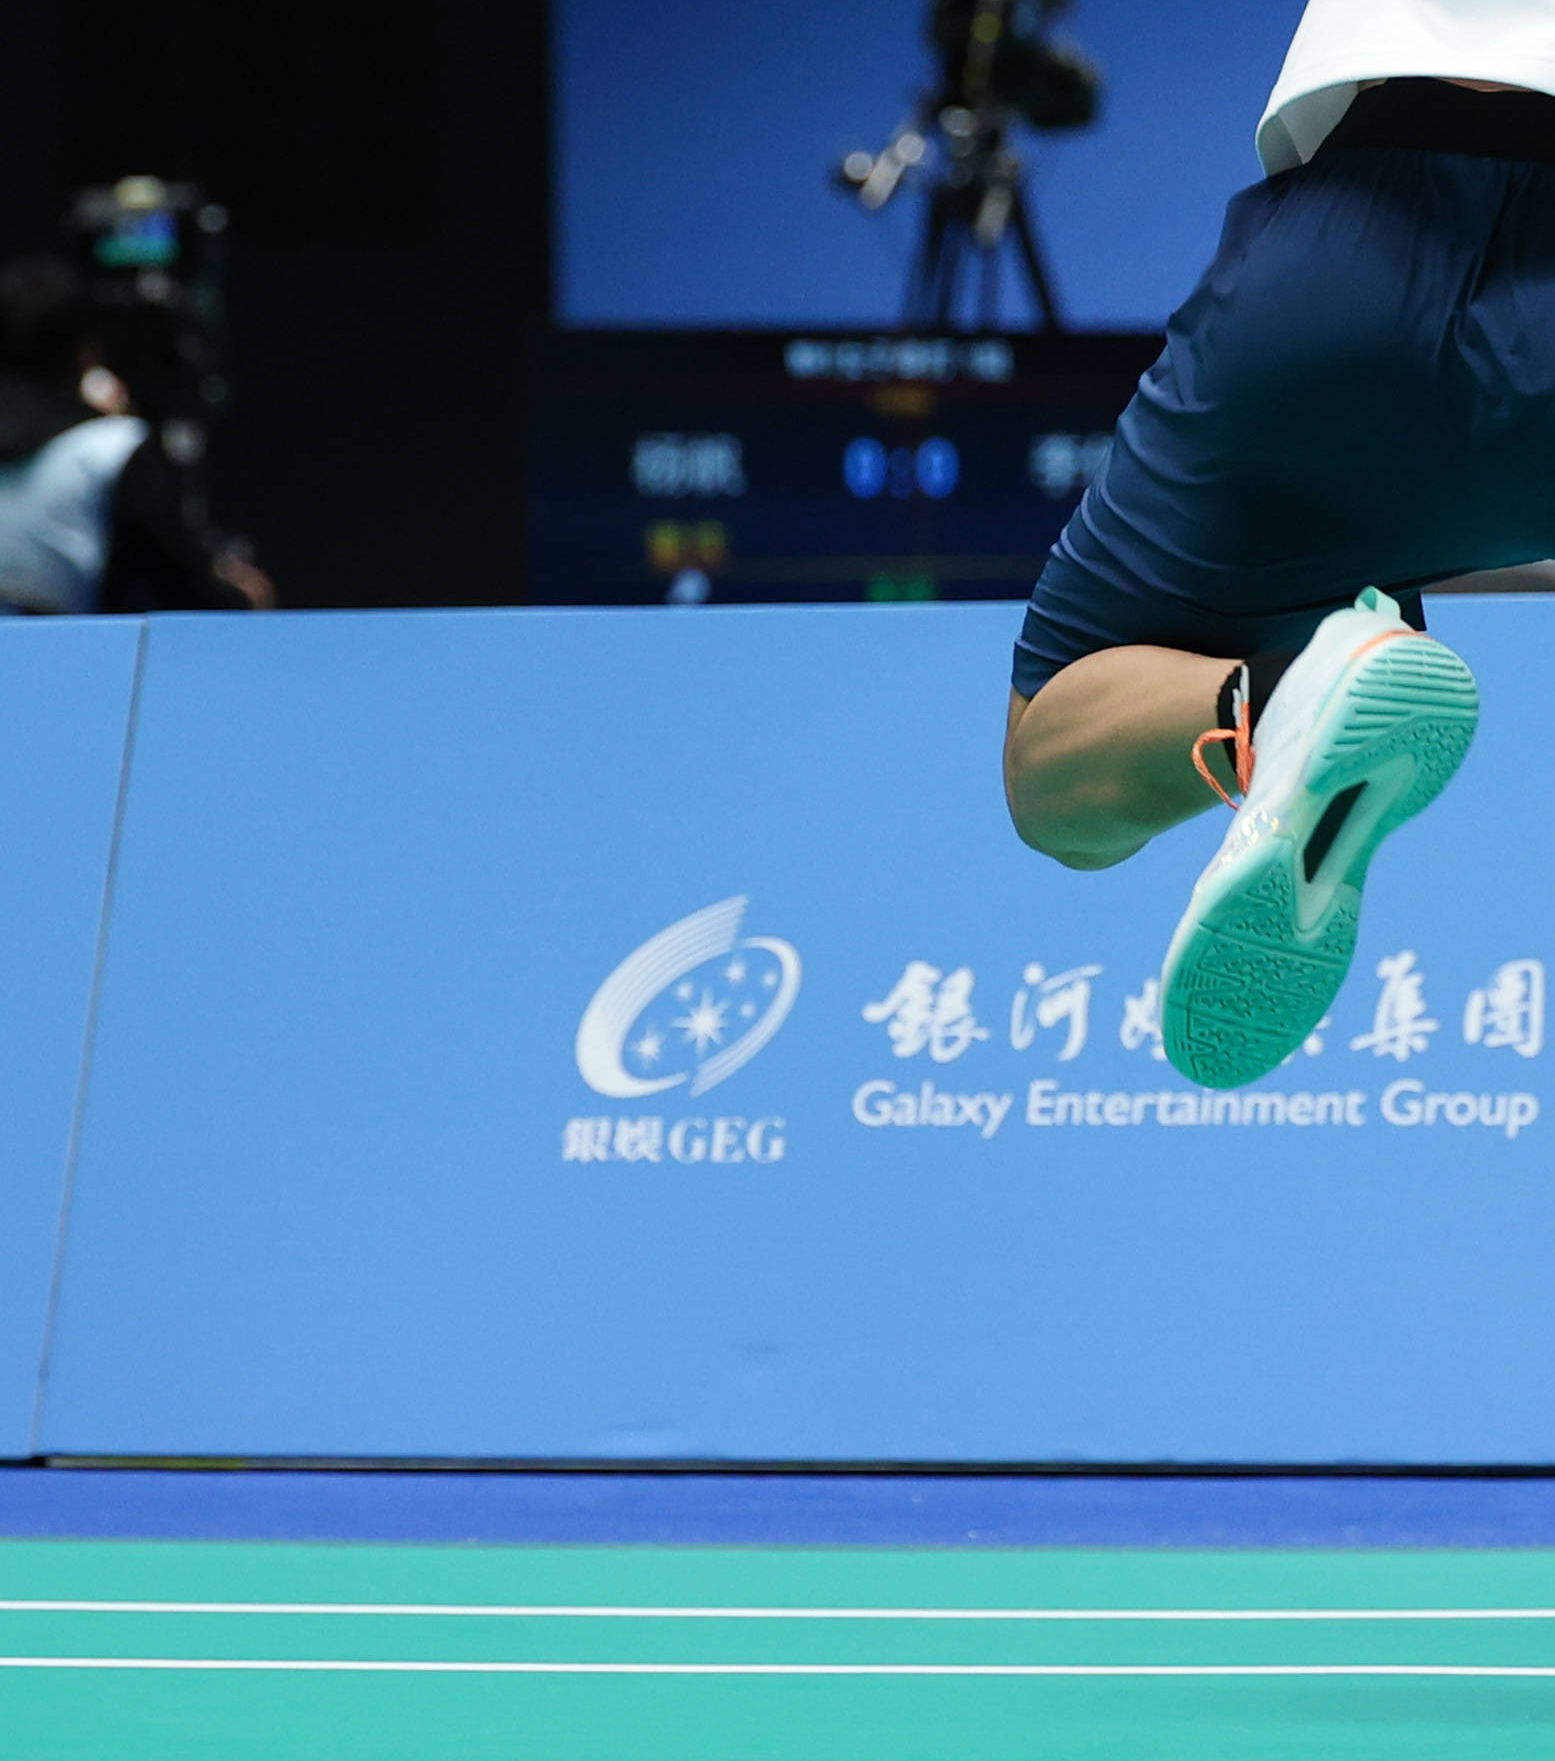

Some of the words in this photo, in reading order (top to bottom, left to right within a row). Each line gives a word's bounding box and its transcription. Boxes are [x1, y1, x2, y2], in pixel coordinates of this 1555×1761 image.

[852, 1079, 1013, 1138] Galaxy
[1026, 1079, 1366, 1126] Entertainment
[1380, 1078, 1539, 1139] Group
